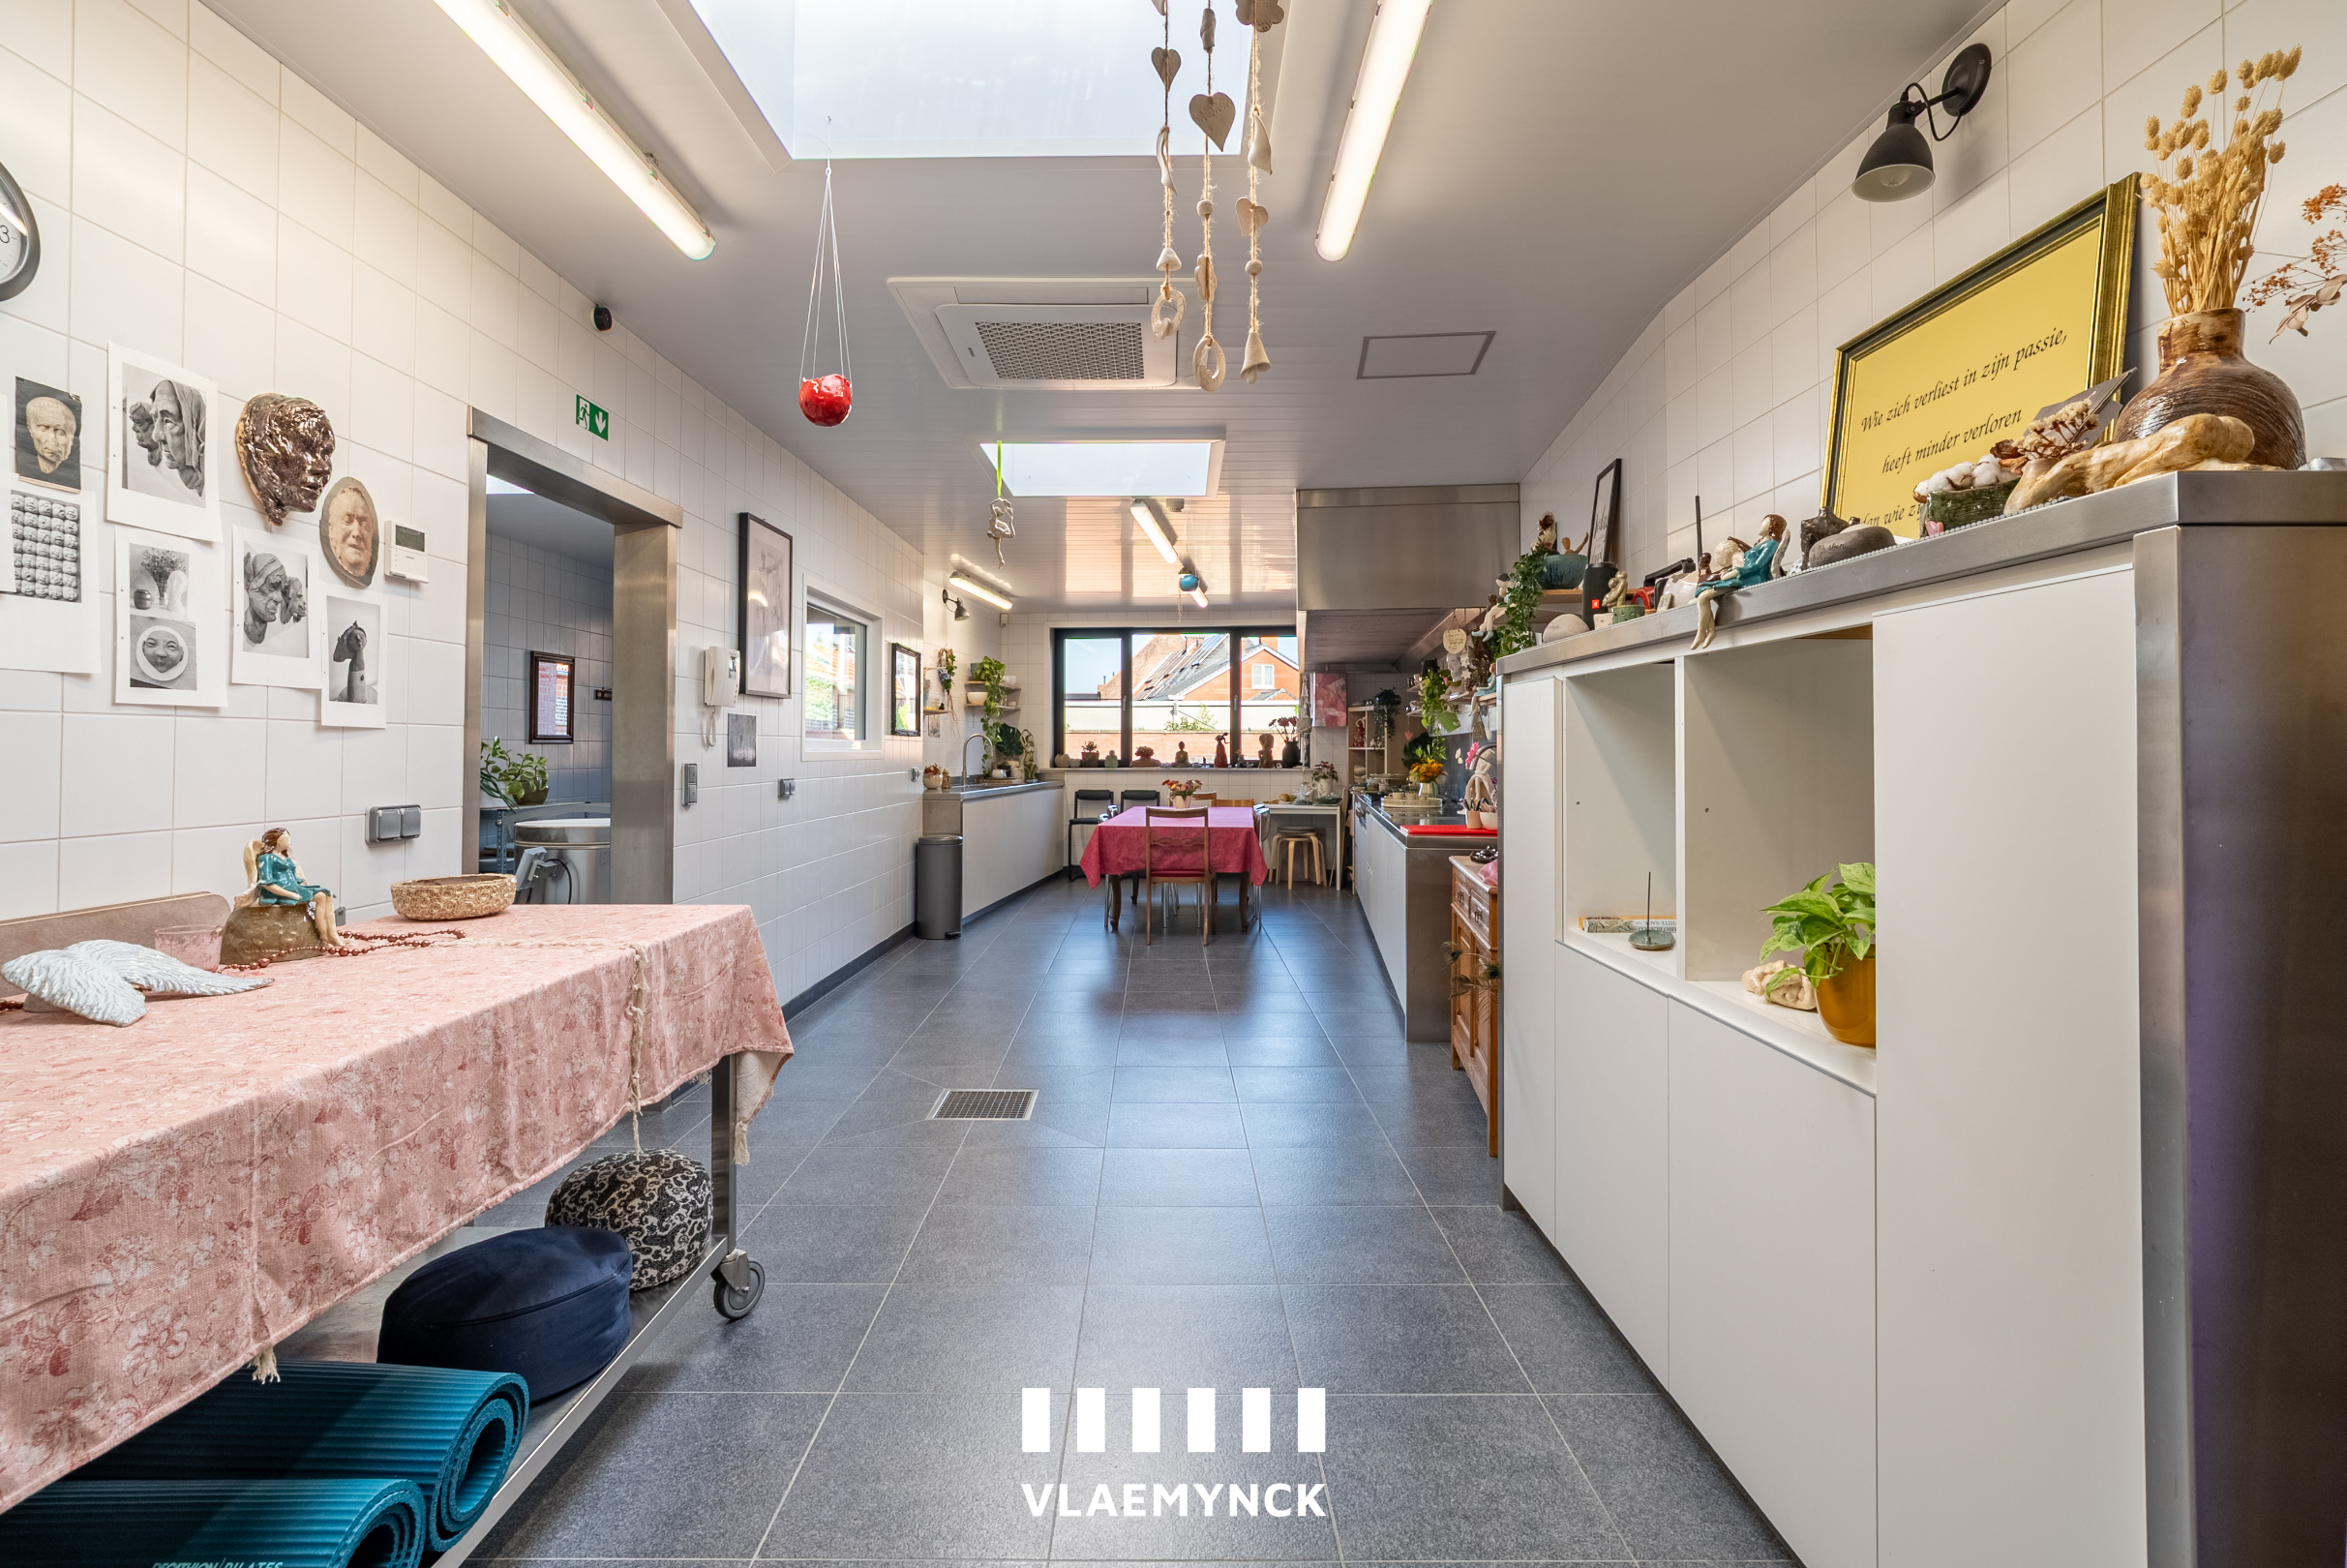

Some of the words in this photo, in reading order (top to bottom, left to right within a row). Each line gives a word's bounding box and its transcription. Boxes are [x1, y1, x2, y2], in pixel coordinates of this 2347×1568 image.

[0, 225, 10, 244] 3
[1861, 410, 1883, 433] Wie
[1885, 394, 1911, 421] zich
[1914, 376, 1959, 409] verliest
[1963, 368, 1977, 387] in
[1980, 352, 2010, 380] zijn
[2012, 327, 2067, 371] passie,
[1881, 446, 1911, 474] heeft
[1914, 431, 1960, 462] minder
[1963, 408, 2022, 443] verloren
[1883, 504, 1905, 525] wie
